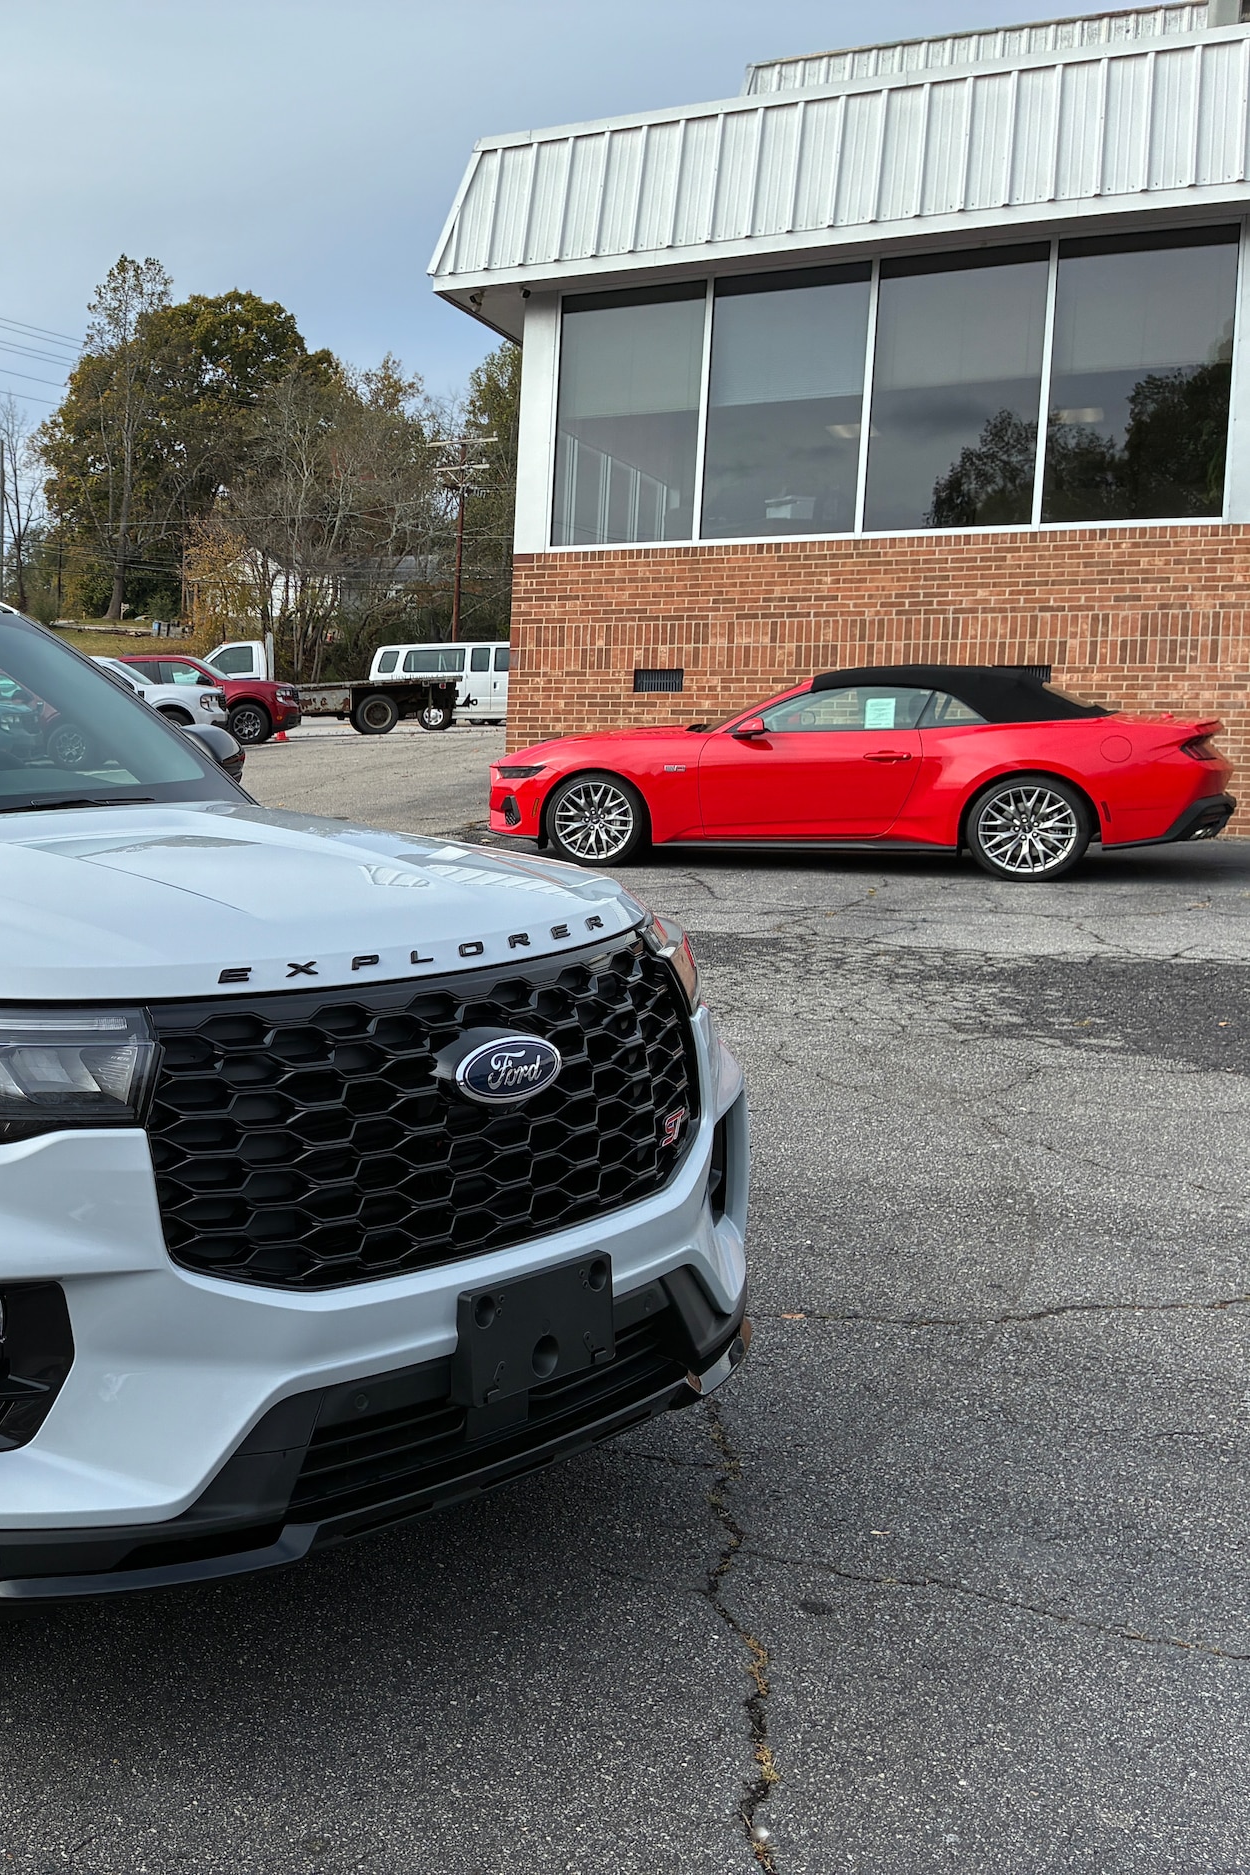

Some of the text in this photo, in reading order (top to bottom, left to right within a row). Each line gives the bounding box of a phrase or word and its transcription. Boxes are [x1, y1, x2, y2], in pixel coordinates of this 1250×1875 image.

[217, 914, 605, 984] EXPLORER
[487, 1049, 542, 1090] Ford
[661, 1106, 686, 1147] ST
